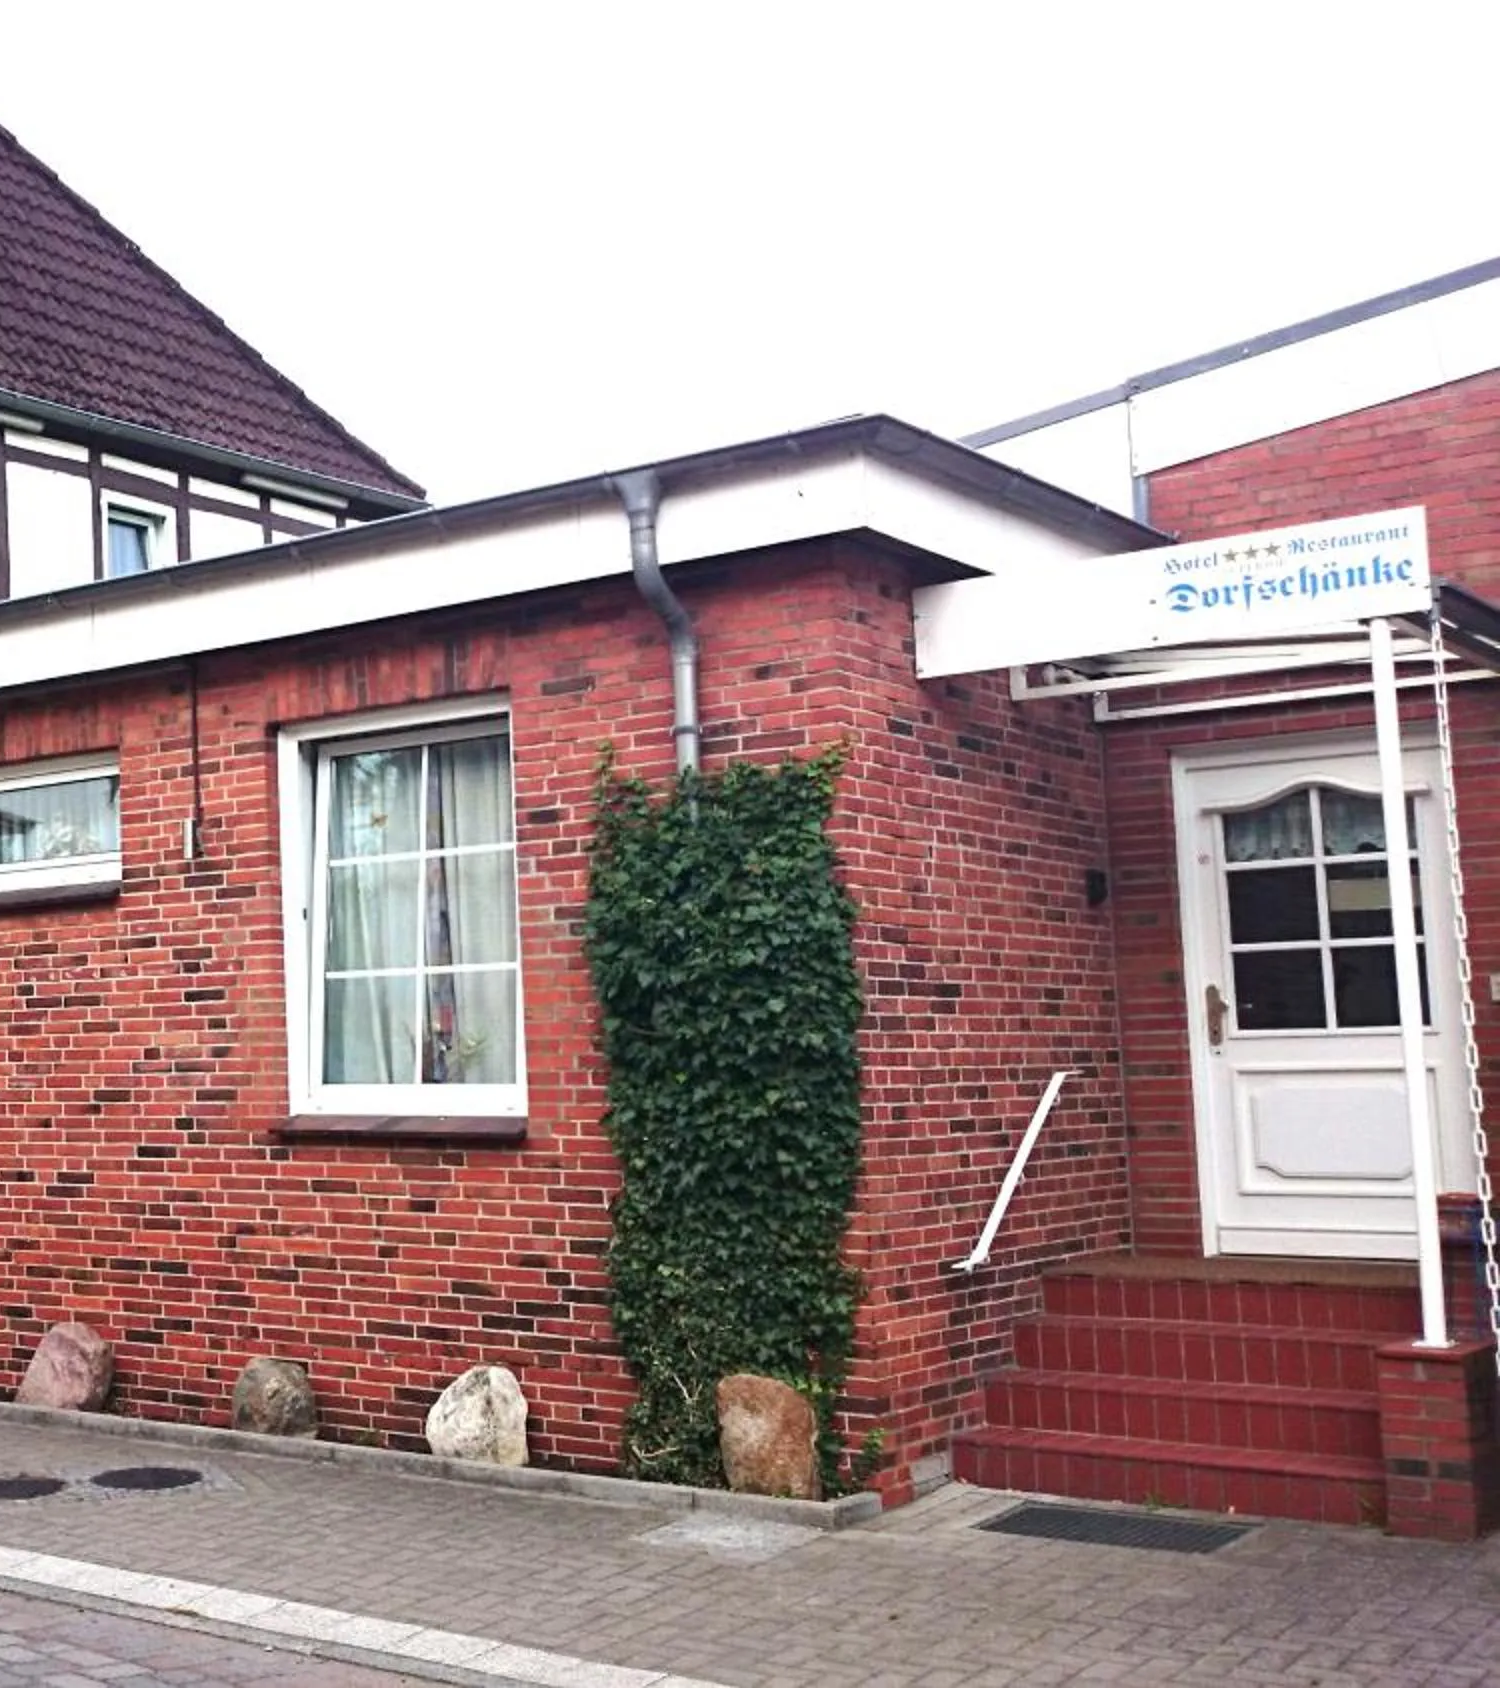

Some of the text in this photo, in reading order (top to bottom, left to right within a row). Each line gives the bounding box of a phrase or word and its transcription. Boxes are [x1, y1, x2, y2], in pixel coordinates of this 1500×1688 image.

[1164, 552, 1218, 575] Hotel
[1287, 525, 1410, 555] Restaurant
[1165, 554, 1413, 613] Dorfschänke
